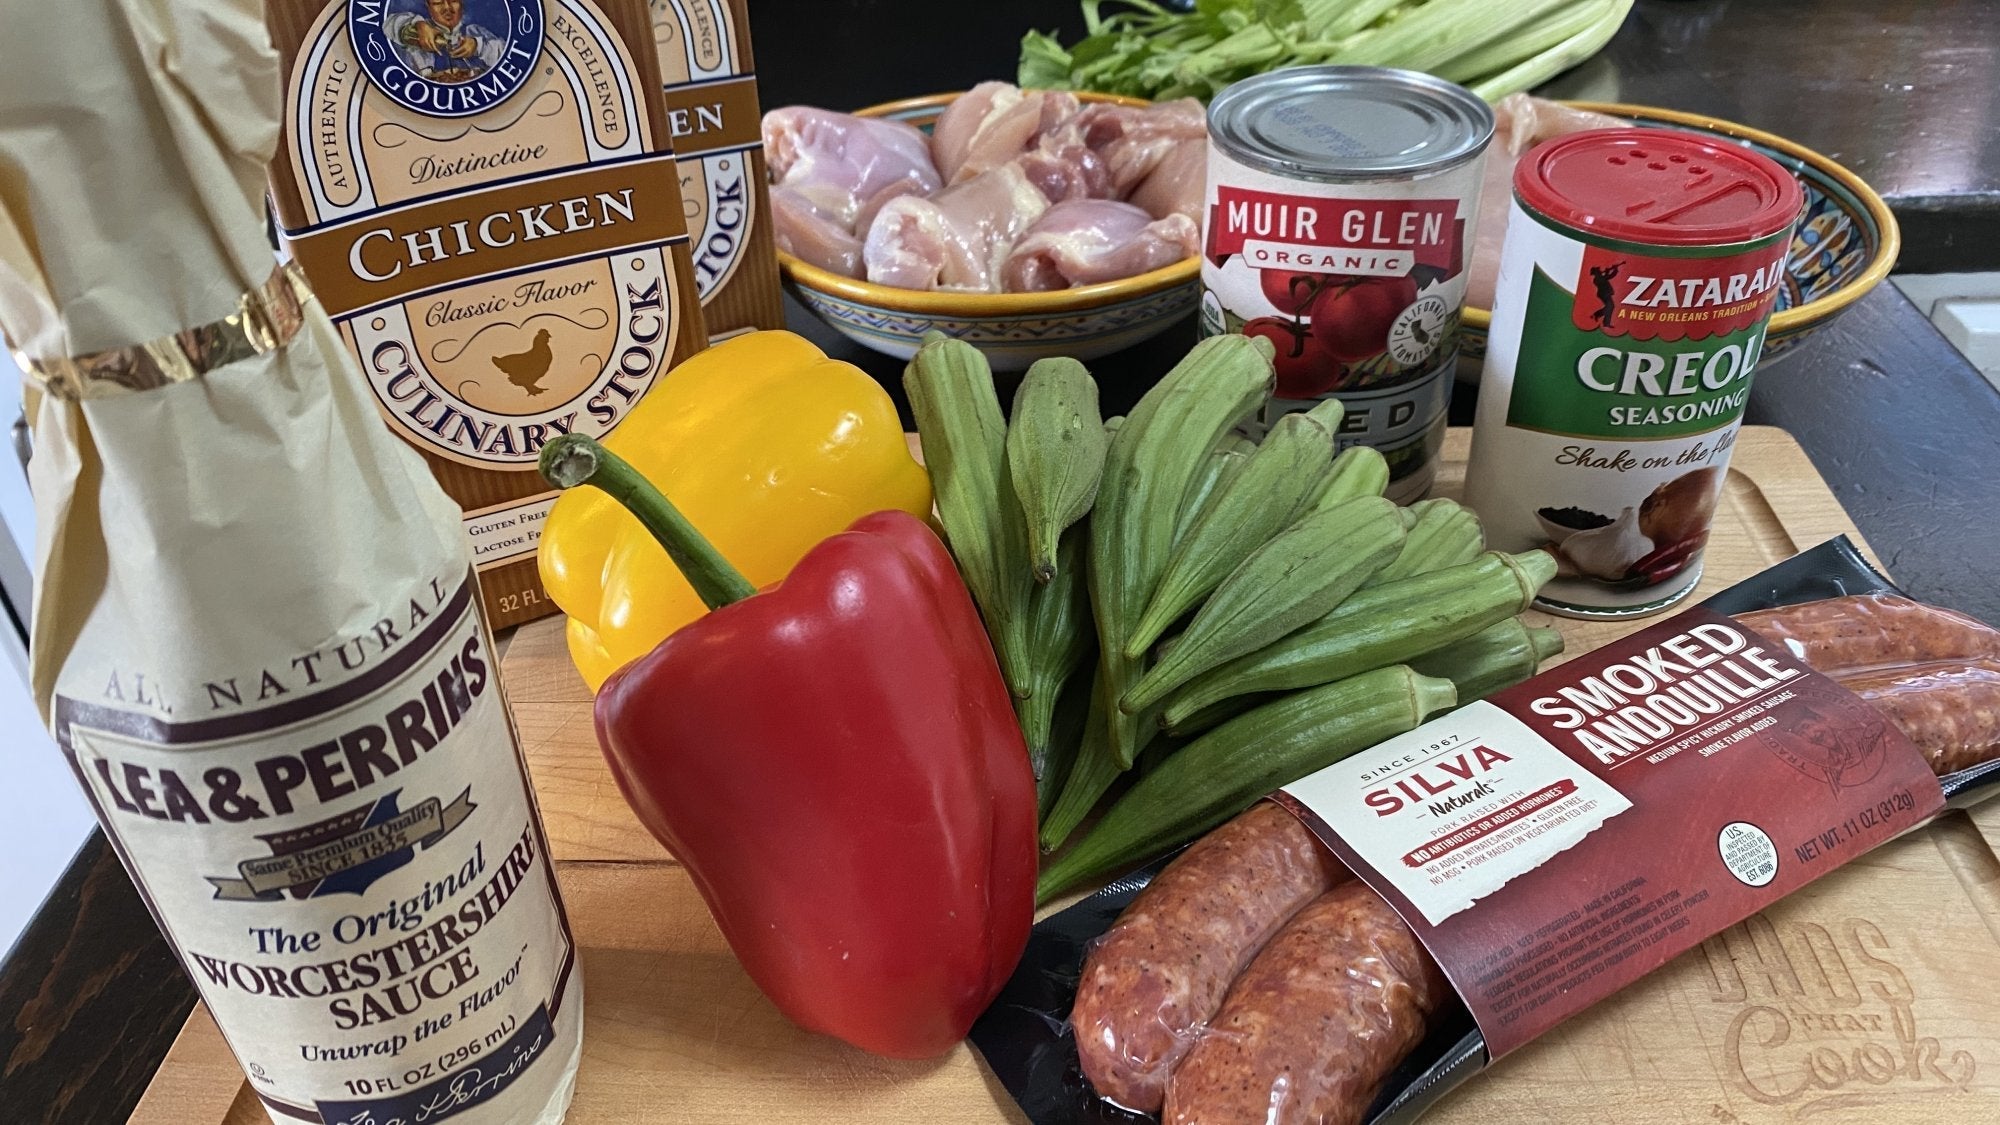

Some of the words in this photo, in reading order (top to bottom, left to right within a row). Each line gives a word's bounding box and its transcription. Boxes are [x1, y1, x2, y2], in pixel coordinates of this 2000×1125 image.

[382, 40, 532, 111] GOURMET
[553, 15, 619, 134] EXCELLENCE
[322, 59, 349, 189] AUTHENTIC
[410, 142, 549, 185] Distinctive
[348, 188, 635, 283] CHICKEN
[1228, 200, 1318, 240] MUIR
[1343, 209, 1444, 245] GLEN
[1255, 249, 1400, 270] ORGANIC
[1621, 256, 1786, 308] ZATARAIN
[425, 295, 509, 328] Classic
[513, 279, 598, 308] Flavor
[1393, 301, 1445, 336] CALIFORNIA
[1618, 310, 1626, 319] A
[1629, 311, 1656, 321] NEW
[1659, 311, 1709, 322] ORLEANS
[1712, 301, 1758, 319] TRADITION
[372, 339, 578, 456] CULINARY
[586, 276, 664, 428] STOCK
[1393, 330, 1441, 362] TOMATOES
[1577, 334, 1760, 396] CREOL
[1609, 387, 1747, 425] SEASONING
[1555, 445, 1638, 472] Shake
[1642, 452, 1673, 468] on
[1676, 441, 1708, 466] the
[519, 510, 548, 524] FREE
[499, 594, 520, 613] 32
[522, 589, 541, 606] FL
[202, 575, 447, 711] NATURAL
[1530, 623, 1747, 730] SMOKED
[1572, 646, 1800, 765] ANDOUILLE
[1645, 743, 1681, 765] MEDIUM
[1677, 734, 1703, 750] SPICY
[1700, 719, 1735, 739] HICKORY
[1731, 704, 1765, 724] SMOKED
[1761, 689, 1797, 709] SAUSAGE
[1361, 754, 1415, 781] SINCE
[1421, 734, 1461, 755] 1967
[1698, 741, 1728, 758] SMOKE
[1723, 727, 1754, 746] FLAVOR
[1750, 716, 1778, 733] ADDED
[1364, 744, 1514, 818] SILVA
[1427, 780, 1495, 818] Naturals
[245, 855, 292, 877] Same
[294, 827, 376, 867] Premium
[379, 800, 437, 840] Quality
[1411, 849, 1432, 863] NO
[1428, 826, 1480, 855] ANTIBIOTICS
[1478, 820, 1494, 831] OR
[1490, 808, 1520, 826] ADDED
[1426, 865, 1440, 875] NO
[1439, 852, 1465, 870] ADDED
[1537, 805, 1566, 821] GLUTEN
[1563, 795, 1585, 808] FREE
[1430, 821, 1460, 838] PORK
[1460, 802, 1498, 824] RAISED
[1498, 790, 1526, 807] WITH
[1794, 838, 1821, 864] NET
[1818, 828, 1845, 851] WT.
[1843, 818, 1861, 838] 11
[1859, 808, 1879, 829] OZ
[1877, 788, 1916, 823] (312g)
[1429, 875, 1444, 886] NO
[1441, 866, 1462, 880] MSG
[1465, 853, 1488, 869] PORK
[1486, 841, 1514, 859] RAISED
[1513, 835, 1527, 846] ON
[1524, 816, 1568, 840] VEGETARIAN
[1565, 808, 1582, 820] FED
[1725, 850, 1738, 861] AND
[1736, 839, 1758, 855] PASSED
[1726, 831, 1756, 850] INSPECTED
[288, 851, 356, 884] SINCE
[189, 820, 536, 999] WORCESTERSHIRE
[249, 926, 321, 955] The
[333, 841, 486, 945] Original
[329, 948, 480, 1031] SAUCE
[300, 1033, 408, 1063] Unwrap
[413, 1013, 453, 1044] the
[1793, 1012, 1883, 1033] THAT
[344, 1078, 373, 1096] 10
[376, 1076, 401, 1094] FL
[403, 1061, 435, 1086] OZ
[438, 1040, 482, 1073] (296
[485, 1014, 516, 1048] mL)
